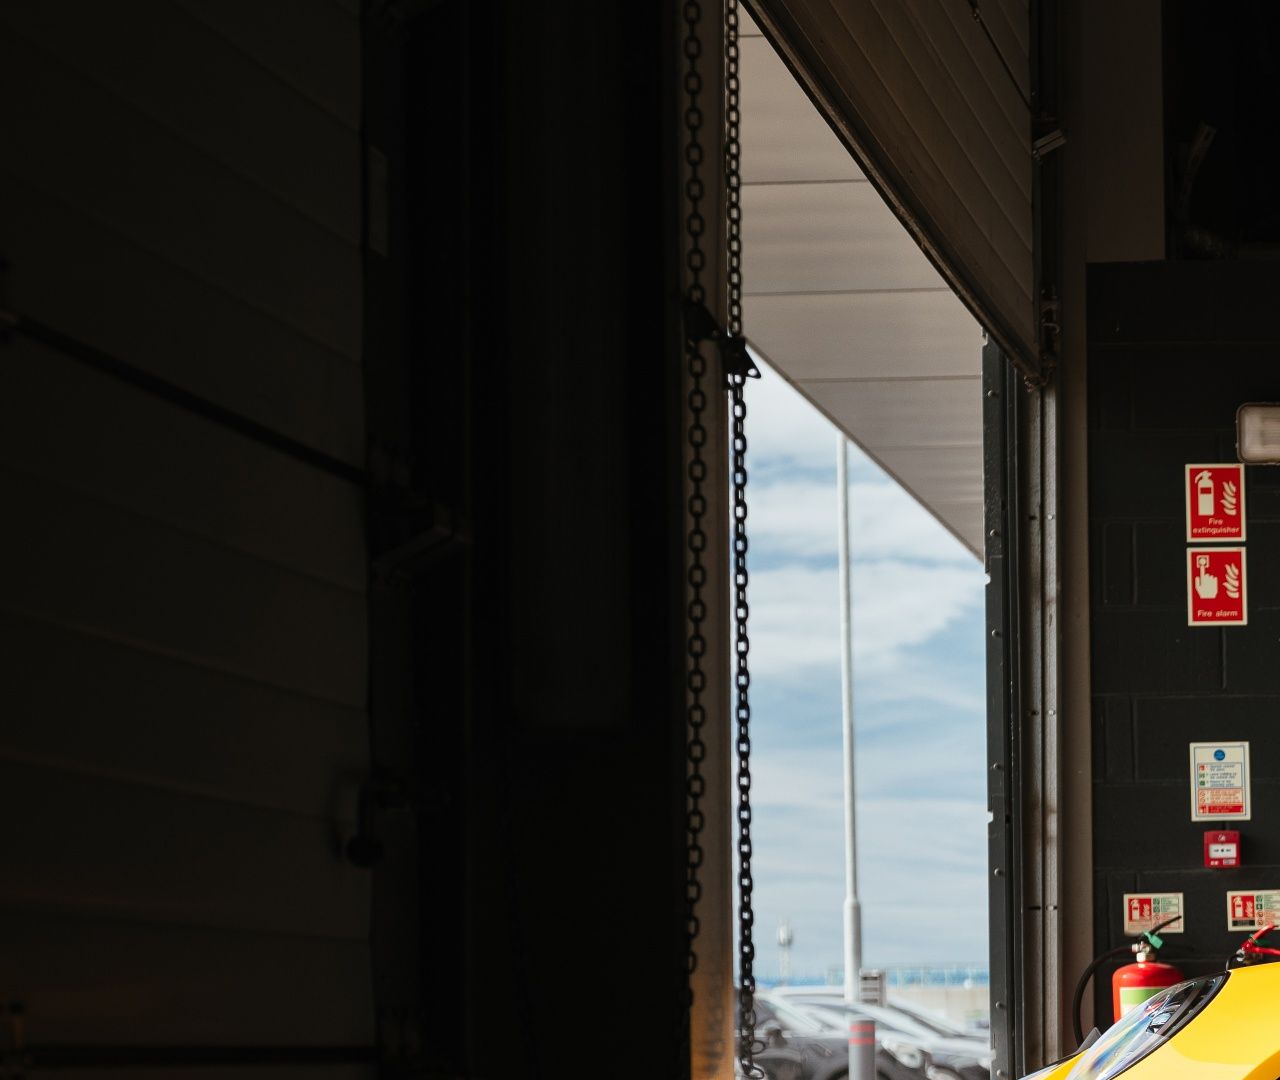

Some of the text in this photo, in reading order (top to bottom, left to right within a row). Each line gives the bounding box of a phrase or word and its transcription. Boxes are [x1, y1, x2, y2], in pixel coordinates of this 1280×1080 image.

[1208, 518, 1223, 526] Fire
[1192, 526, 1240, 535] extinguisher
[1197, 610, 1238, 618] Fire alarm
